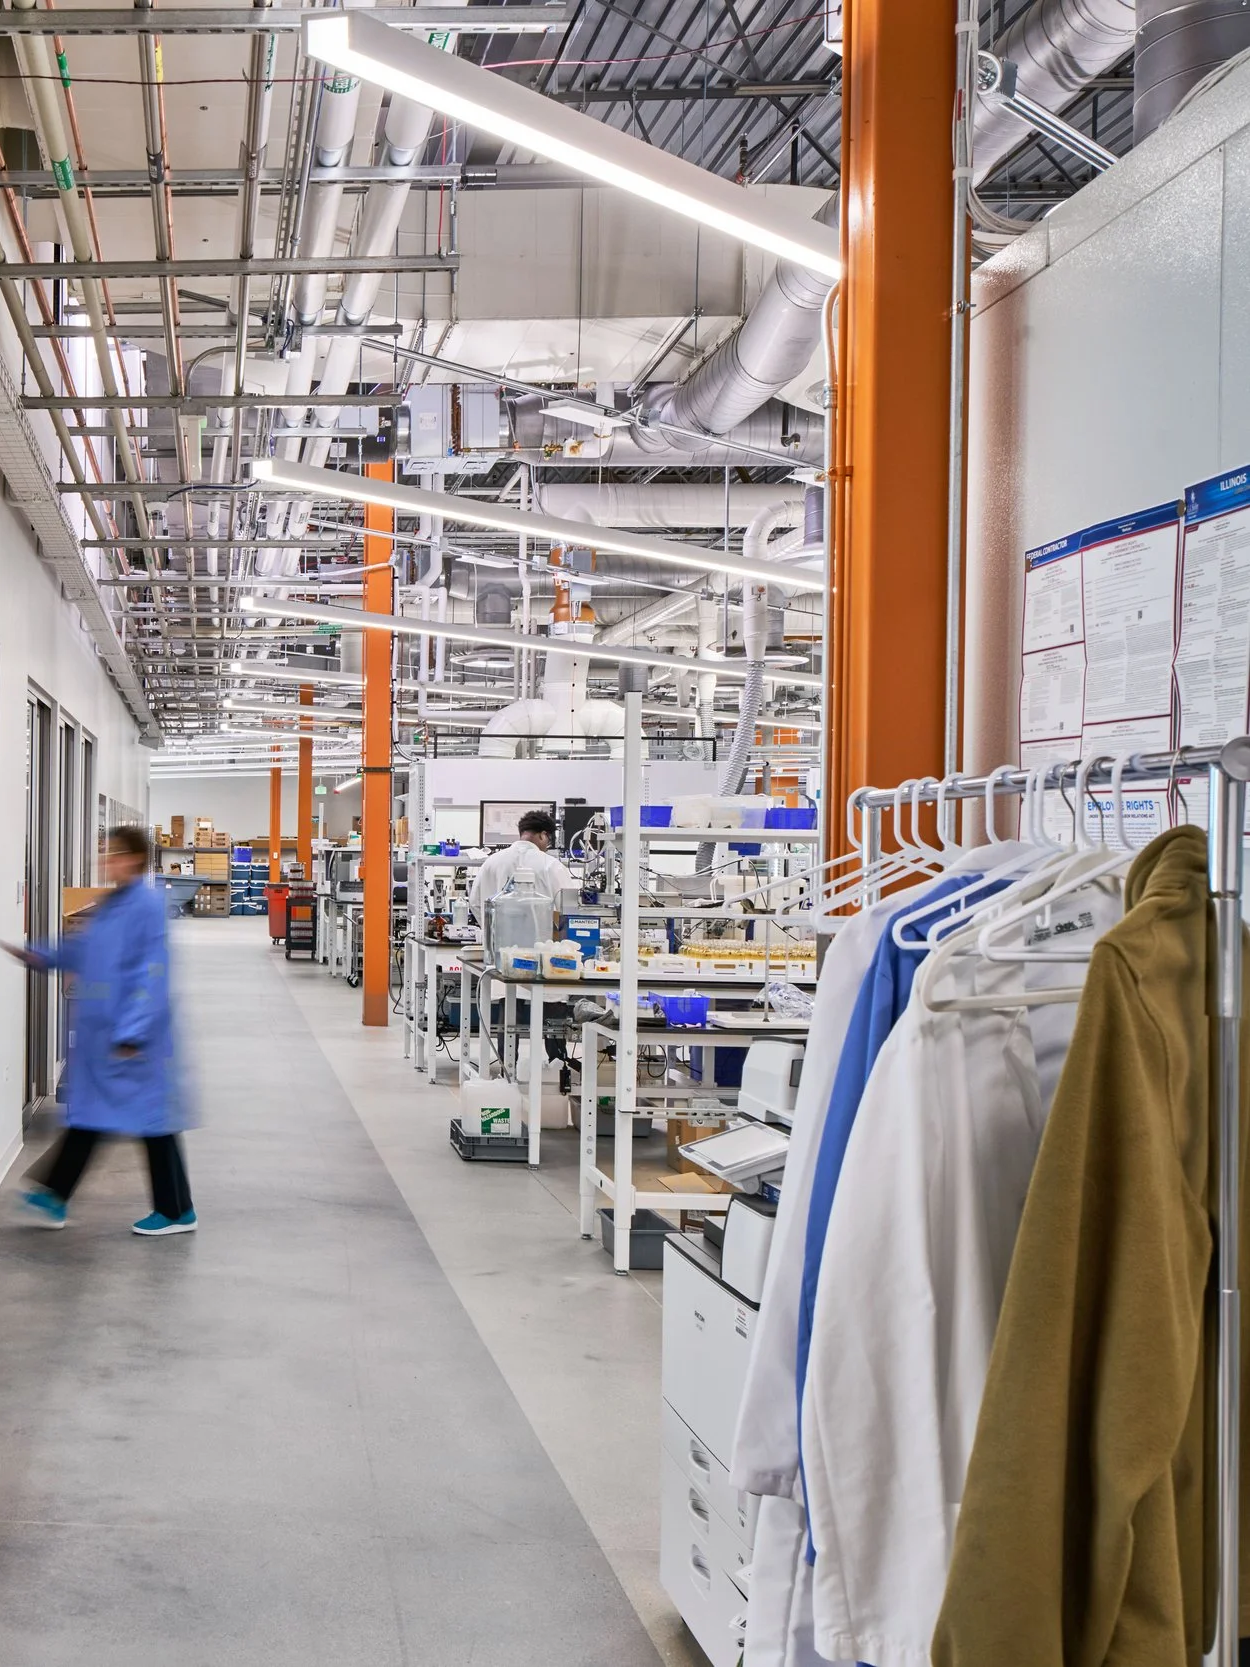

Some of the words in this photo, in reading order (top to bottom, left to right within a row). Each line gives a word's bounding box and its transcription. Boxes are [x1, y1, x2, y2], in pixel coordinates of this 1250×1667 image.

[1220, 473, 1247, 491] ILLINOIS
[1043, 539, 1068, 555] CONTRACTOR
[1126, 800, 1154, 811] RIGHTS
